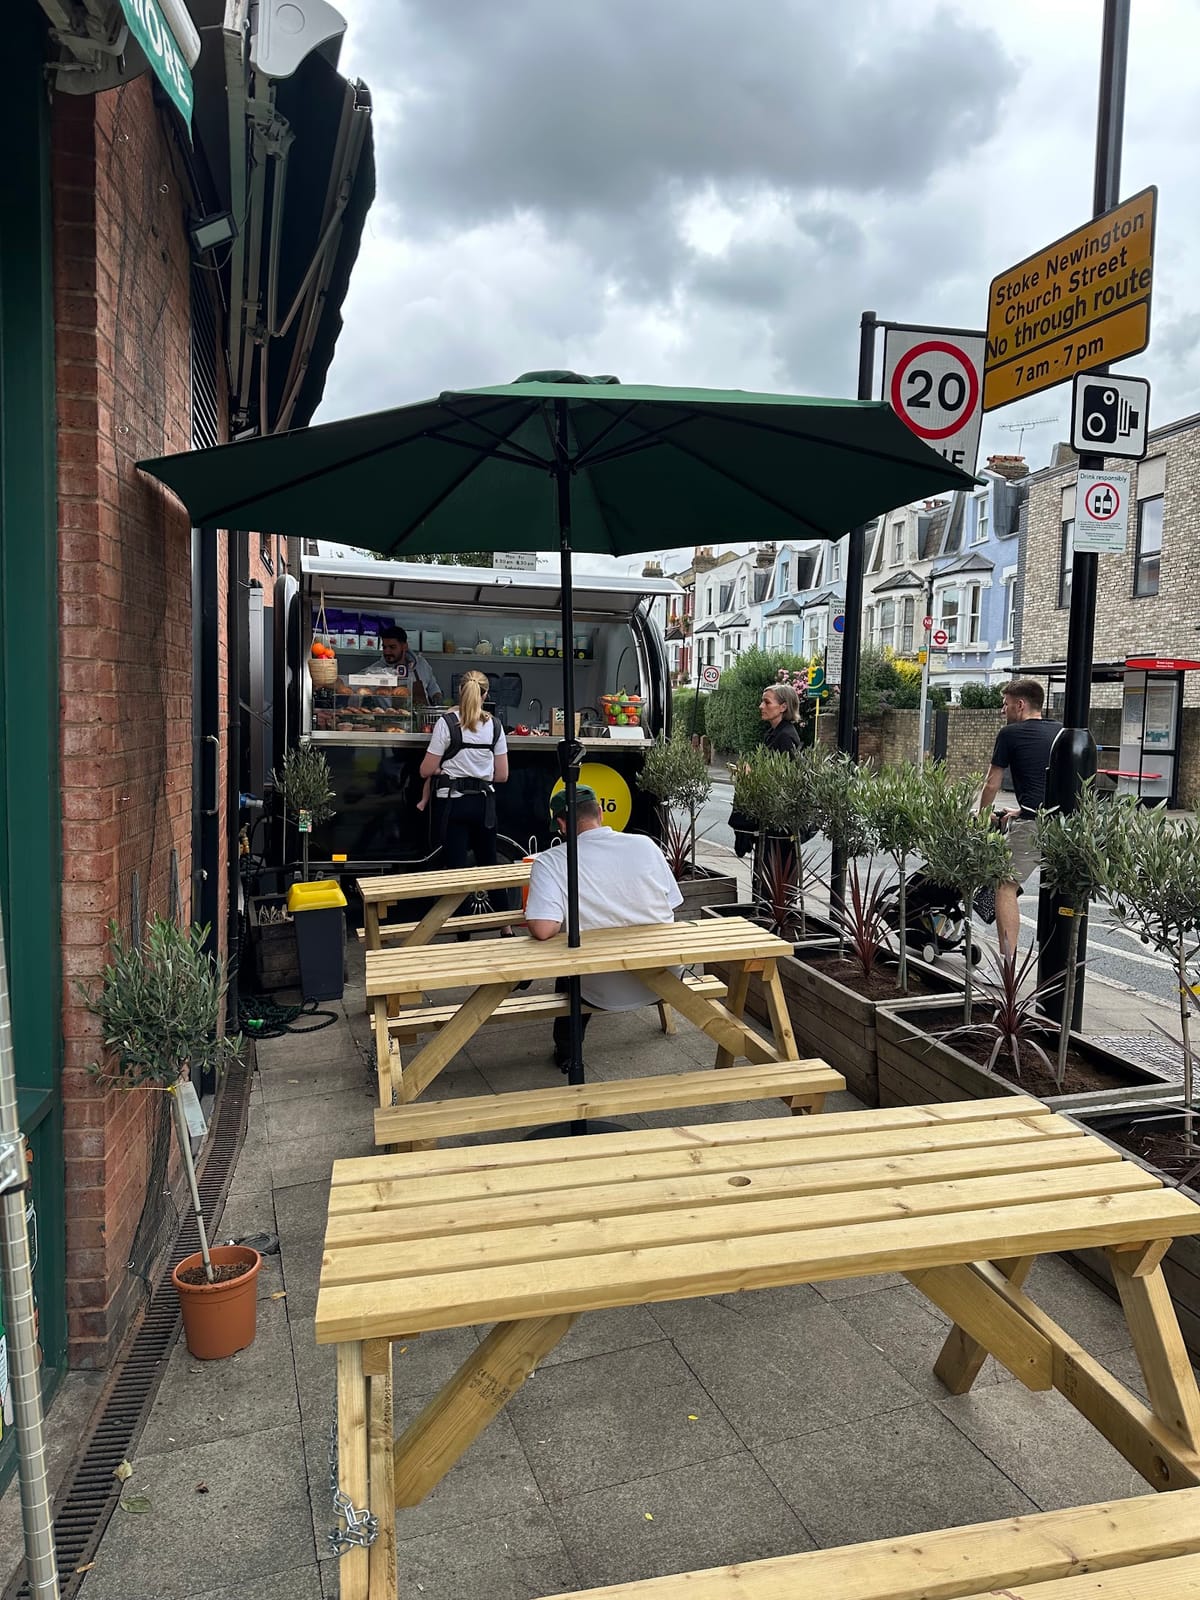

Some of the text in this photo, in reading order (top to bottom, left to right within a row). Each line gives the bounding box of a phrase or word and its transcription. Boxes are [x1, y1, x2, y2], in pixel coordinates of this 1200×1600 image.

[996, 210, 1145, 307] Stoke Newington
[1005, 246, 1128, 325] Church Street
[986, 267, 1151, 362] No through route
[906, 369, 966, 411] 20
[1080, 473, 1127, 484] Drink responsibly
[706, 671, 717, 679] 20
